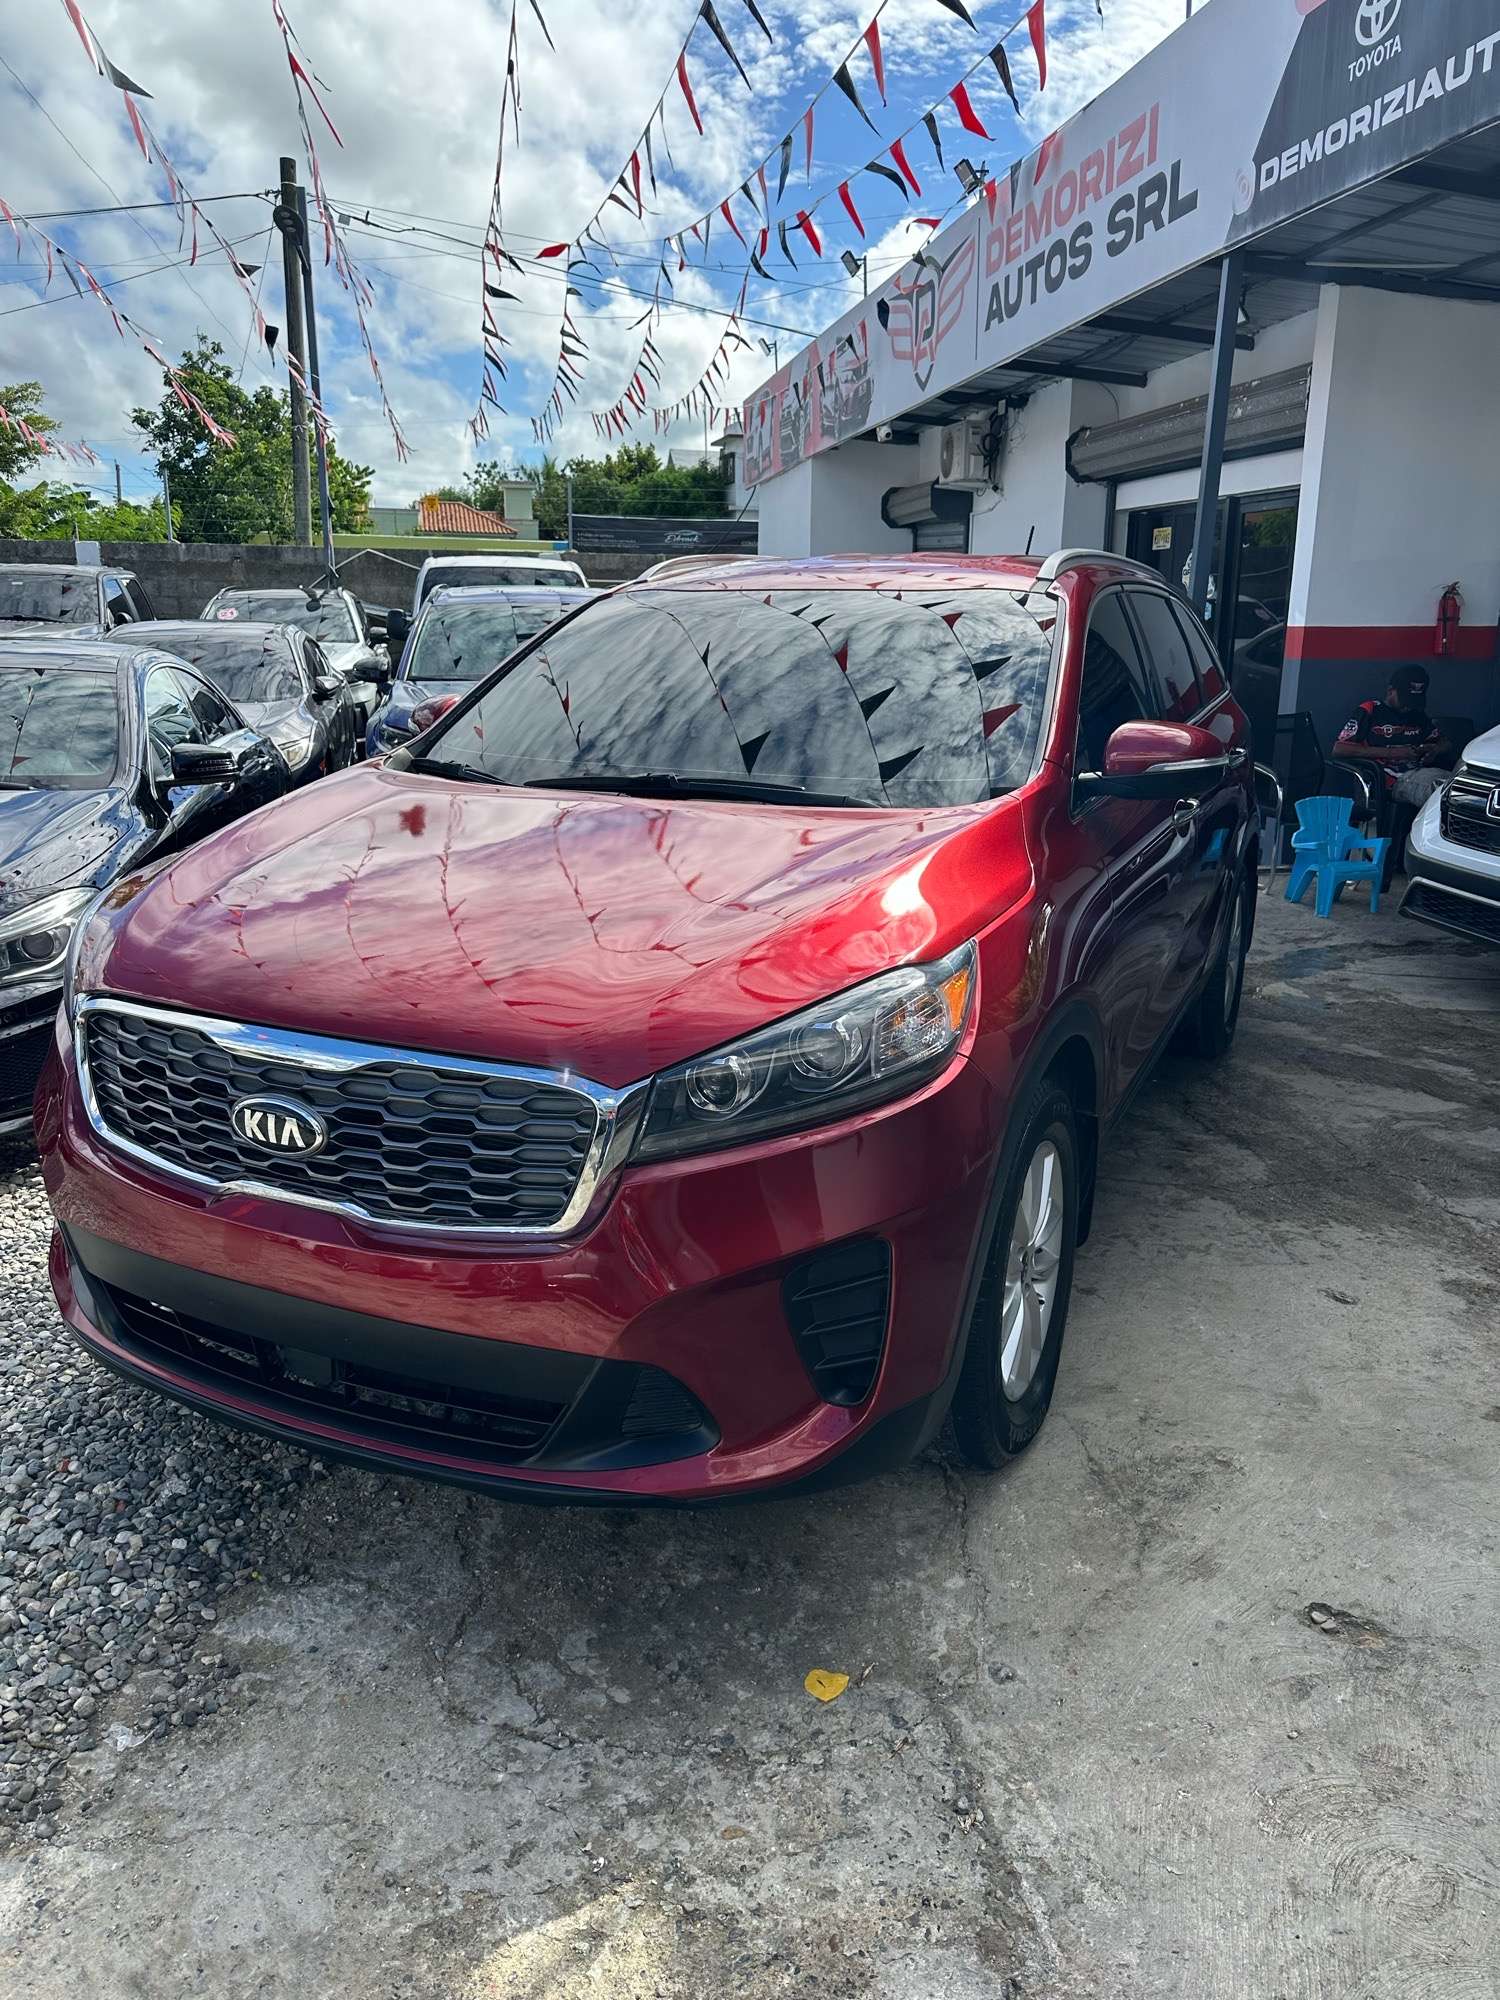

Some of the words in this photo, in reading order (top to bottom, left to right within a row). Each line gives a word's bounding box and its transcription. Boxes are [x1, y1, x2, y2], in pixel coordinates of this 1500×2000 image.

[1348, 35, 1402, 82] TOYOTA
[984, 221, 1094, 332] AUTOS
[1106, 158, 1199, 258] SRL
[985, 102, 1160, 279] DEMORIZI
[243, 1108, 306, 1148] KIA
